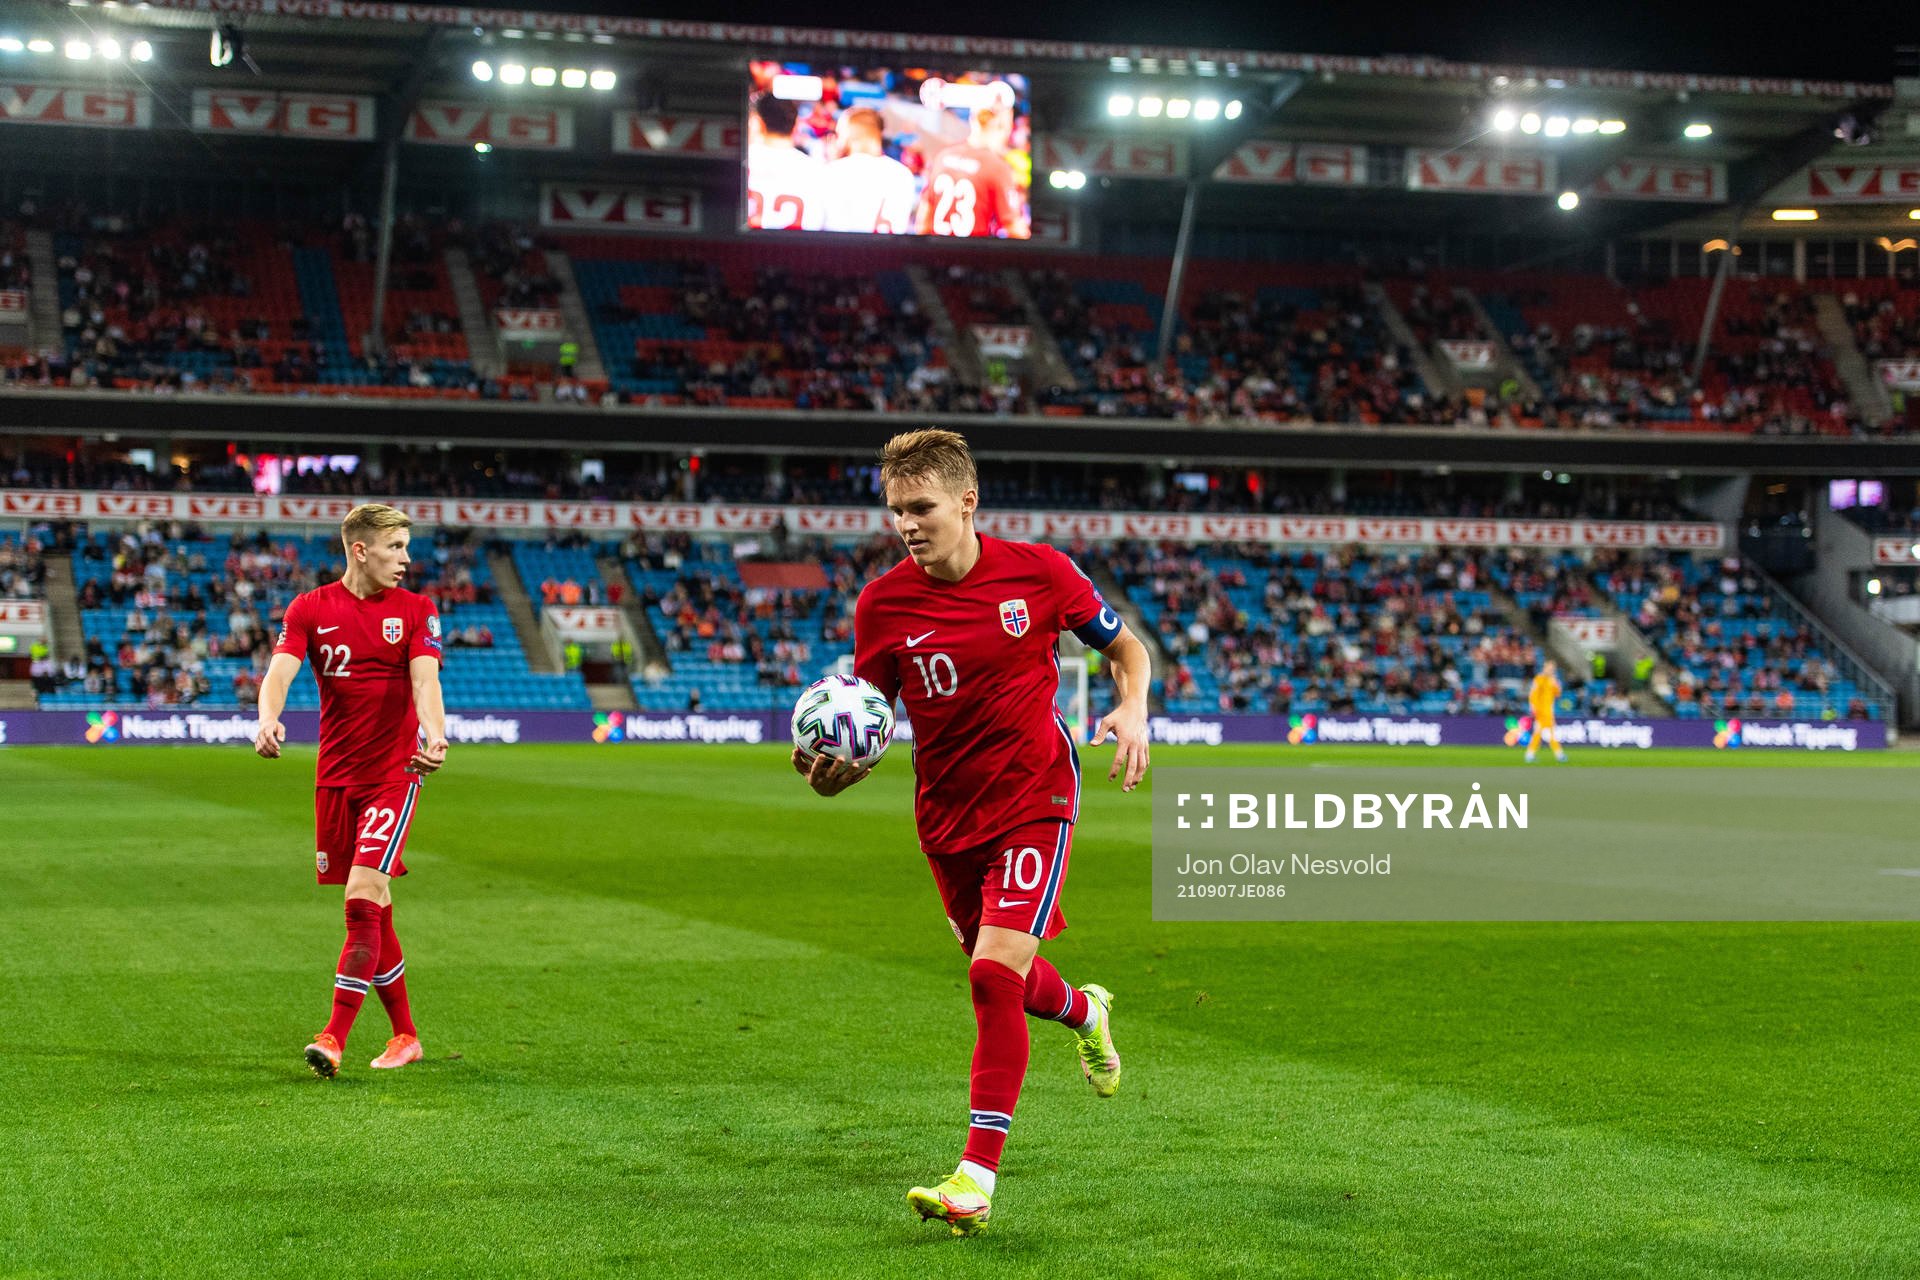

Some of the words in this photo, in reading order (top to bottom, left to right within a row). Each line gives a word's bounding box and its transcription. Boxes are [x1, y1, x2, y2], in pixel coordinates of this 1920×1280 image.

[0, 84, 135, 124] VG
[209, 95, 357, 137] VG
[414, 106, 556, 146] VG
[630, 114, 742, 153] VG
[1043, 135, 1176, 176] VG
[1227, 144, 1361, 183] VG
[1420, 155, 1544, 191] VG
[1600, 162, 1726, 199] VG
[1809, 166, 1920, 197] VG
[552, 187, 693, 226] VG
[933, 174, 976, 237] 23
[4, 494, 81, 514] VG
[97, 495, 173, 516] VG
[189, 497, 262, 517] VG
[280, 498, 352, 518] VG
[458, 503, 528, 522] VG
[544, 504, 615, 524] VG
[631, 506, 700, 525] VG
[800, 509, 867, 529] VG
[1047, 514, 1112, 534] VG
[1124, 516, 1190, 535] VG
[1203, 517, 1268, 537] VG
[1281, 518, 1345, 538] VG
[1357, 520, 1421, 540] VG
[1433, 521, 1497, 541] VG
[1510, 523, 1571, 543] VG
[1583, 524, 1645, 544] VG
[1656, 525, 1718, 545] VG
[548, 608, 620, 629] VG
[1099, 606, 1118, 630] C
[320, 644, 351, 677] 22
[913, 652, 958, 698] 10
[122, 715, 187, 739] Norsk
[445, 714, 520, 743] Tipping
[626, 715, 688, 739] Norsk
[686, 716, 763, 744] Tipping
[1149, 717, 1223, 745] Tipping
[1318, 718, 1373, 742] Norsk
[1372, 718, 1442, 746] Tipping
[1585, 720, 1653, 748] Tipping
[1742, 723, 1794, 746] Norsk
[1793, 723, 1858, 751] Tipping
[360, 806, 395, 841] 22
[1003, 847, 1043, 890] 10
